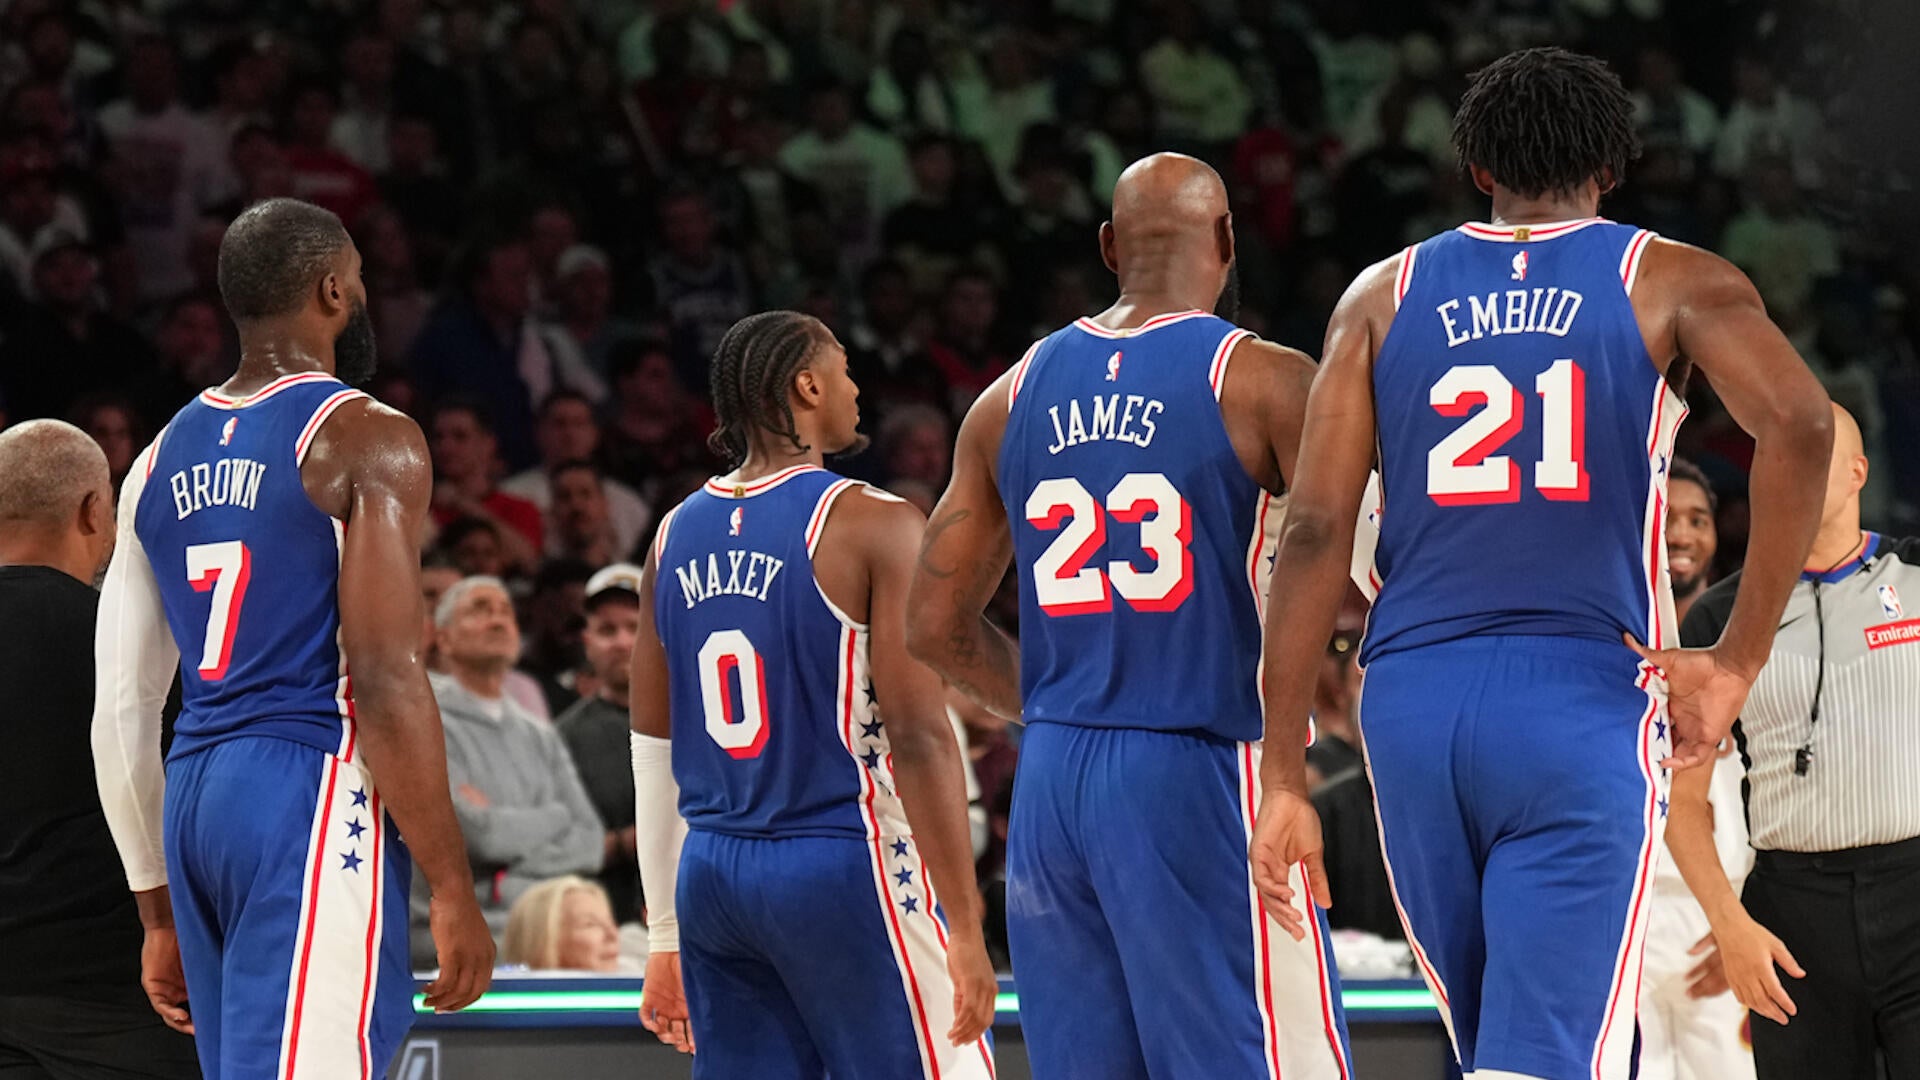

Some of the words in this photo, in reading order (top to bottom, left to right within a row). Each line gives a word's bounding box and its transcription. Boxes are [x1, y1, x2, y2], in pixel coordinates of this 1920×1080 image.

[1436, 287, 1583, 348] EMBIID
[1048, 394, 1165, 455] JAMES
[1427, 359, 1590, 507] 21
[170, 458, 266, 521] BROWN
[675, 550, 783, 609] MAXEY
[1025, 472, 1194, 617] 23
[186, 540, 251, 681] 7
[698, 629, 770, 760] 0
